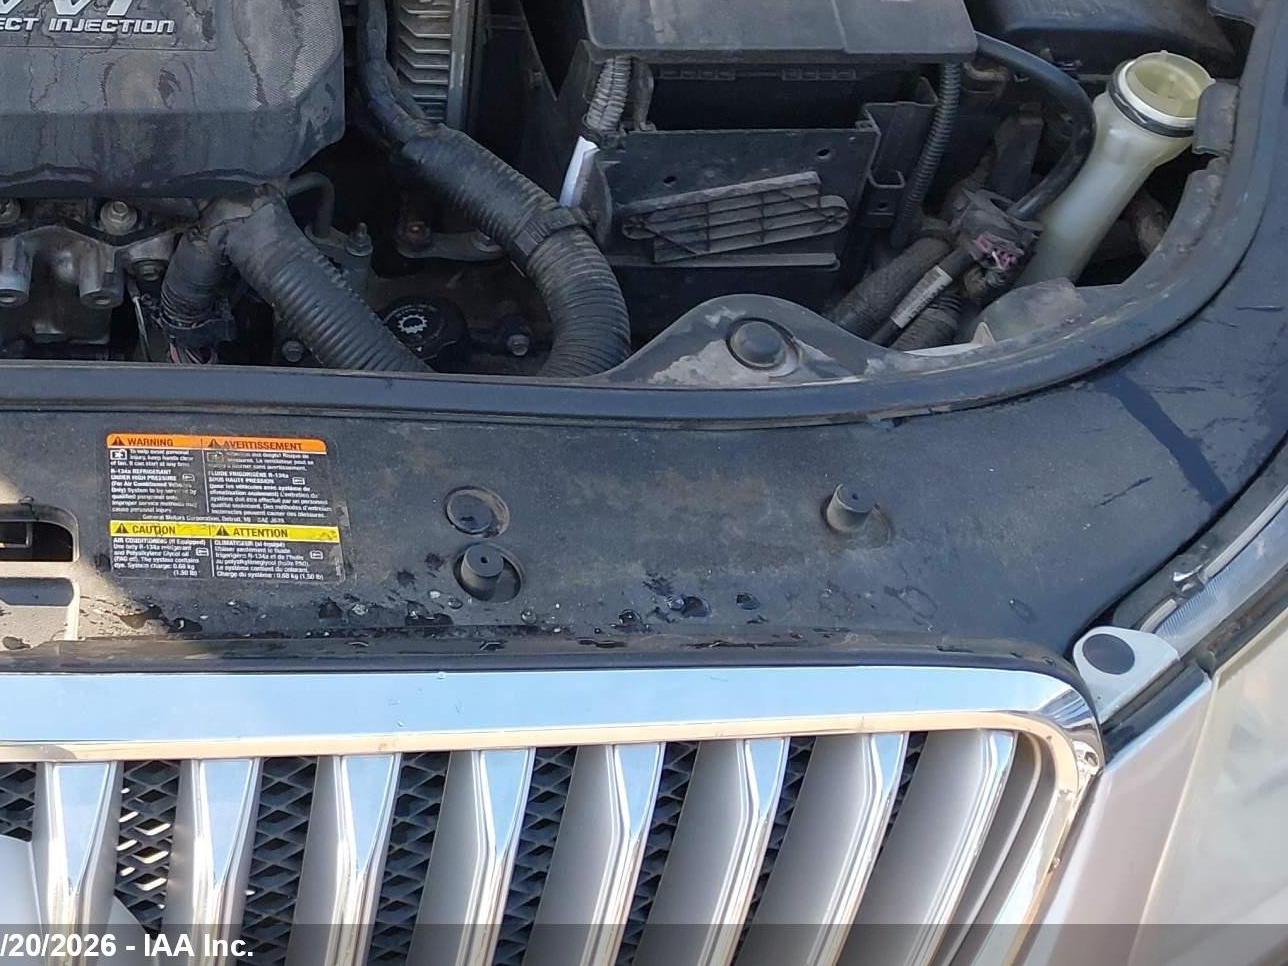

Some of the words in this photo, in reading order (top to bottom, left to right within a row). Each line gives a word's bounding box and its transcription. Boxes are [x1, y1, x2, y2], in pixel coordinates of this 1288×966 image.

[48, 18, 175, 34] INJECTION
[127, 438, 174, 446] WARNING
[223, 441, 303, 450] AVERTISSEMENT
[132, 526, 176, 534] CAUTION
[234, 529, 288, 537] ATTENTION
